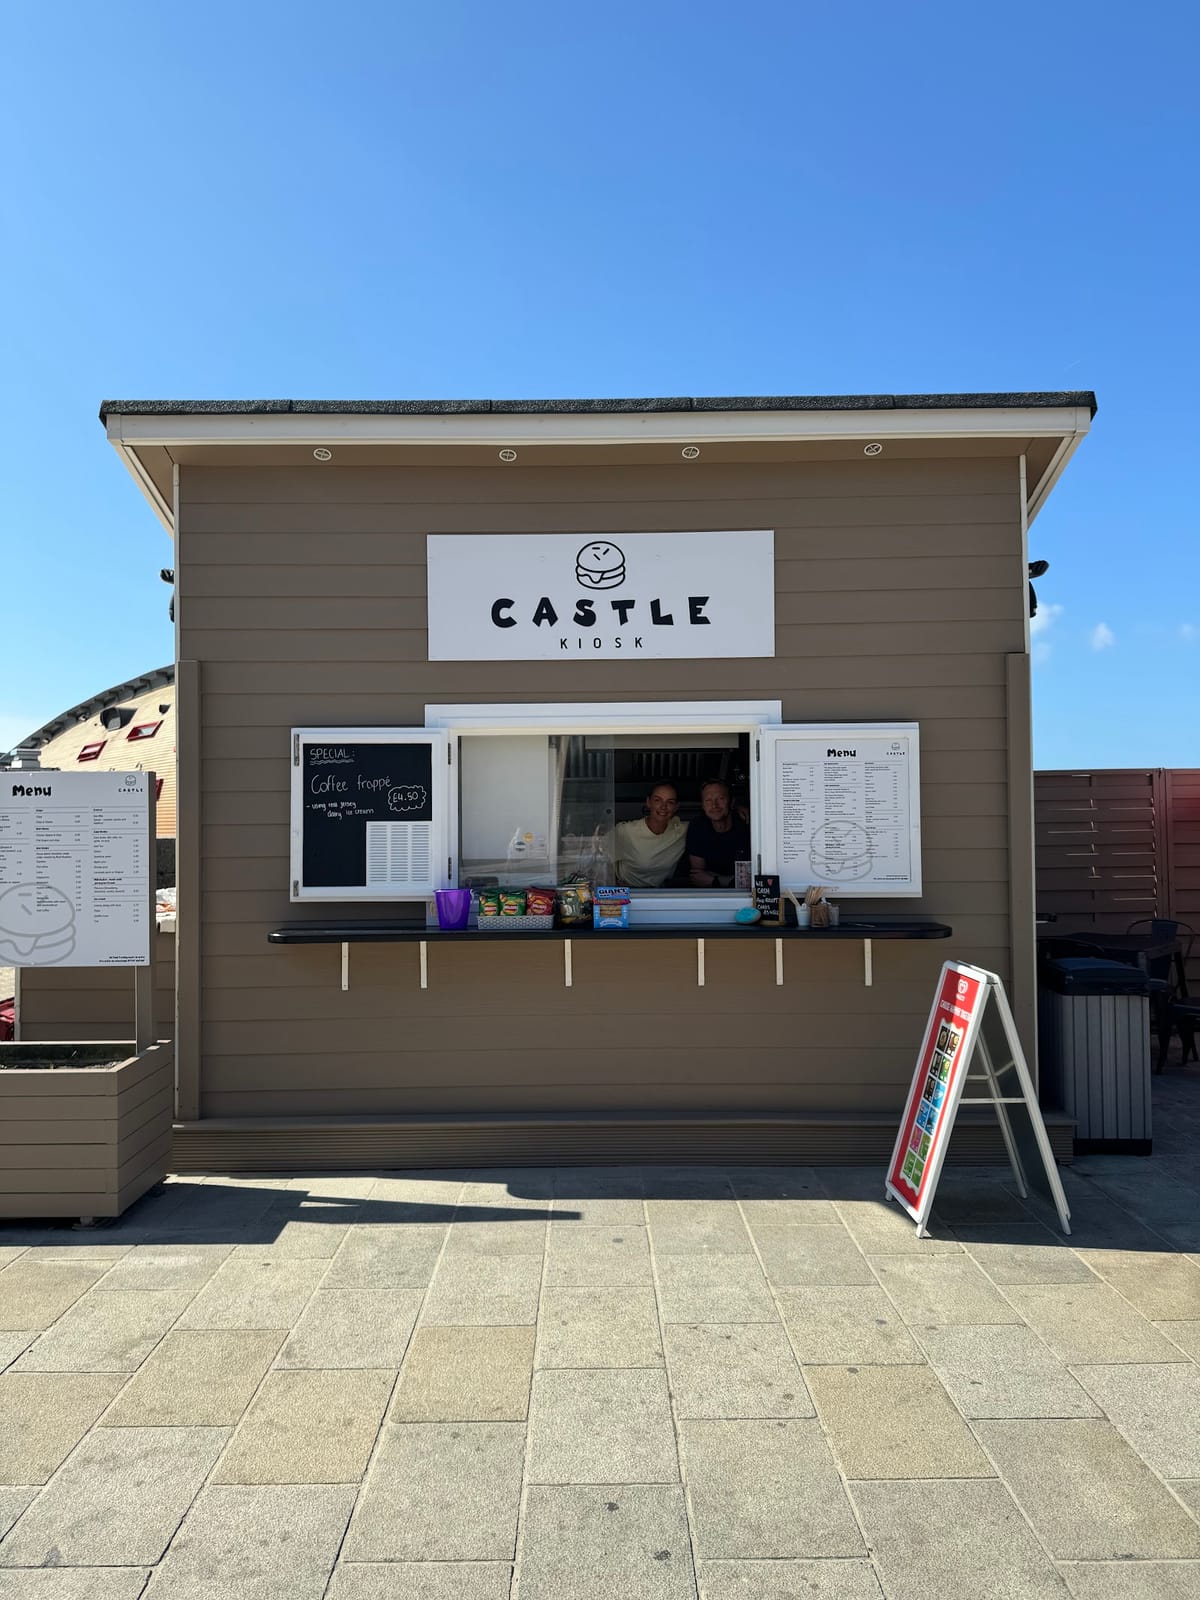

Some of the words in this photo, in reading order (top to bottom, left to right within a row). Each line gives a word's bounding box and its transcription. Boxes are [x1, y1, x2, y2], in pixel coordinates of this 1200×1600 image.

[491, 596, 711, 628] CASTLE
[560, 637, 644, 649] KIOSK
[827, 749, 857, 758] Menu
[311, 774, 349, 794] Coffee
[357, 774, 392, 792] frappé
[12, 785, 52, 797] Menu
[312, 803, 326, 811] using
